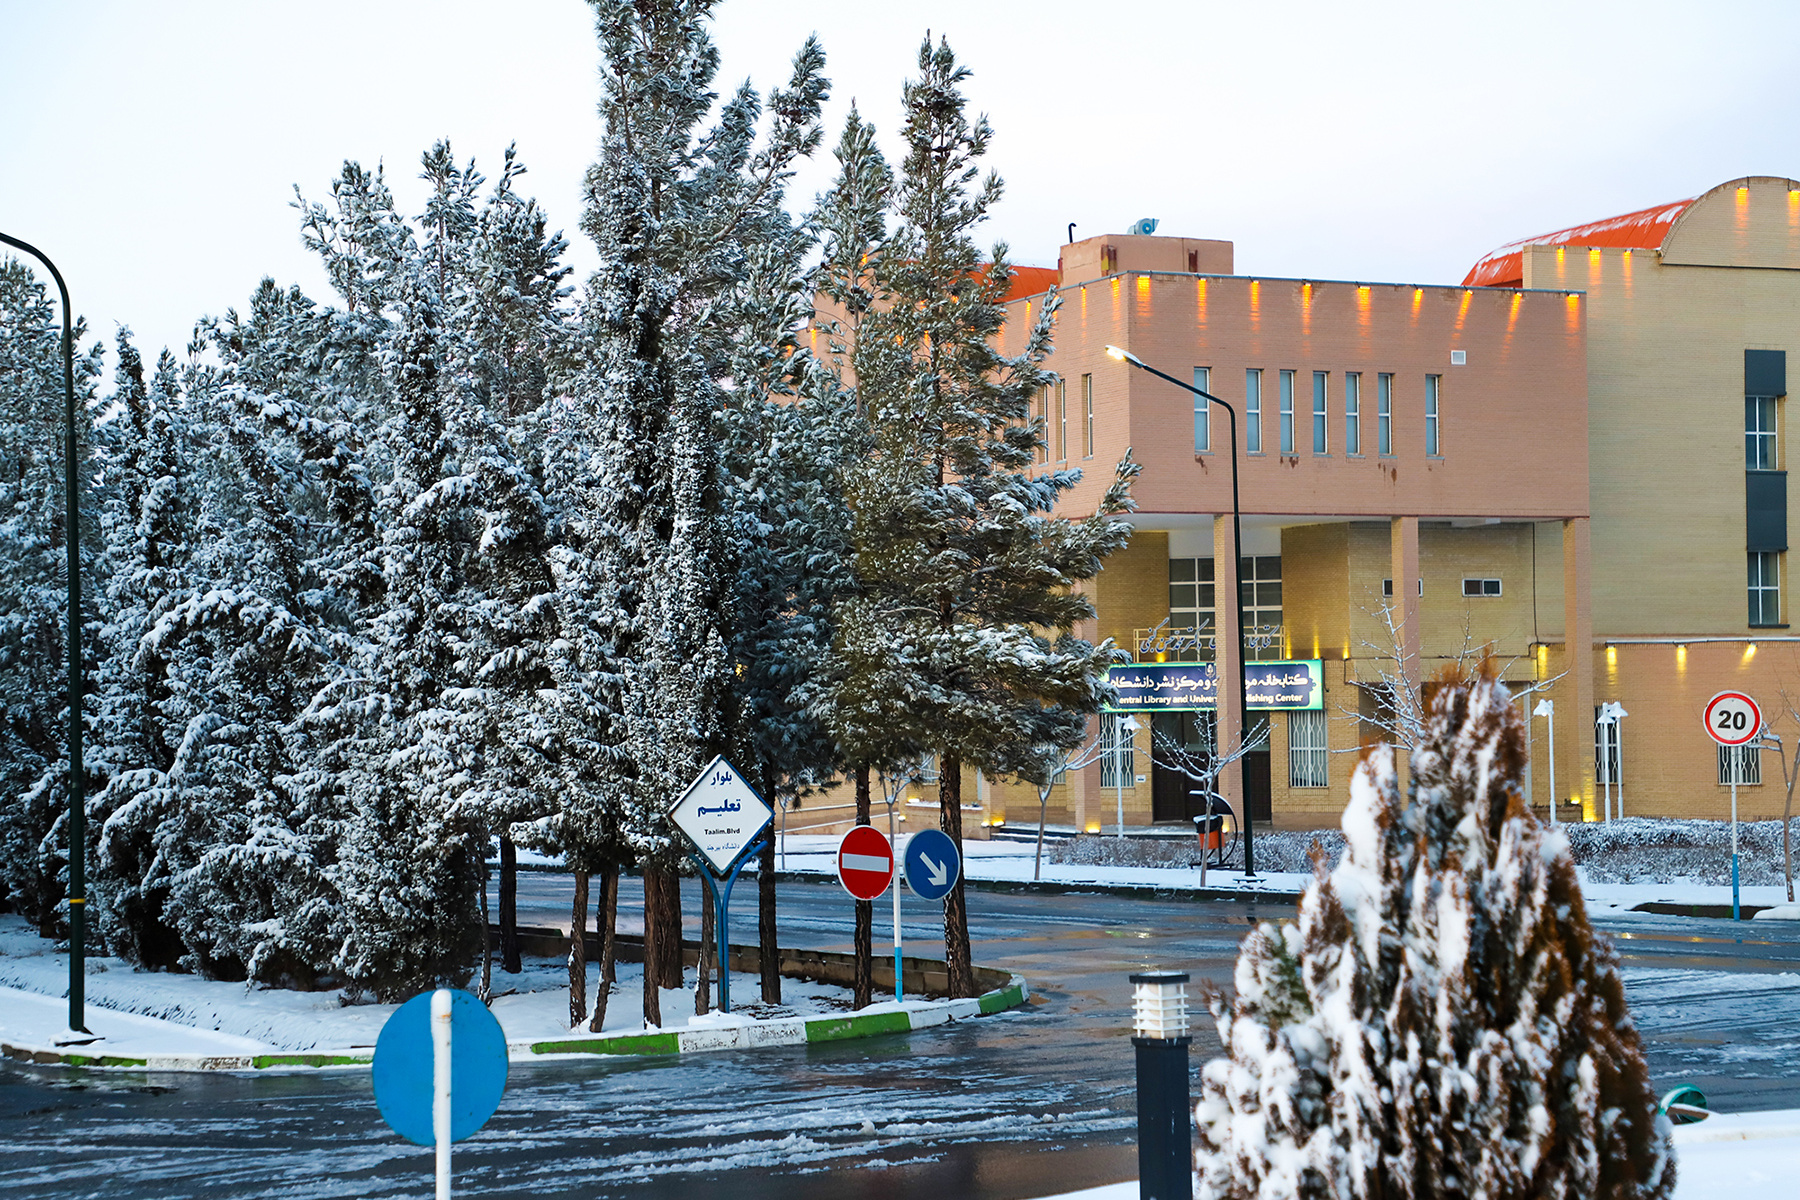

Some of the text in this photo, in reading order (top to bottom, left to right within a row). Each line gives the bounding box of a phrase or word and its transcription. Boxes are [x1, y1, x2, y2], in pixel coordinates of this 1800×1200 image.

[1110, 675, 1155, 689] دانشگاه
[1153, 675, 1175, 691] نشر
[1173, 675, 1203, 691] مرکز
[1258, 673, 1308, 689] کتابخانه
[1119, 695, 1142, 704] entral
[1144, 695, 1171, 705] Library
[1173, 694, 1188, 704] and
[1275, 694, 1303, 703] Center
[1717, 710, 1746, 730] 20
[710, 771, 733, 786] بلوار
[697, 798, 741, 817] تعلیم
